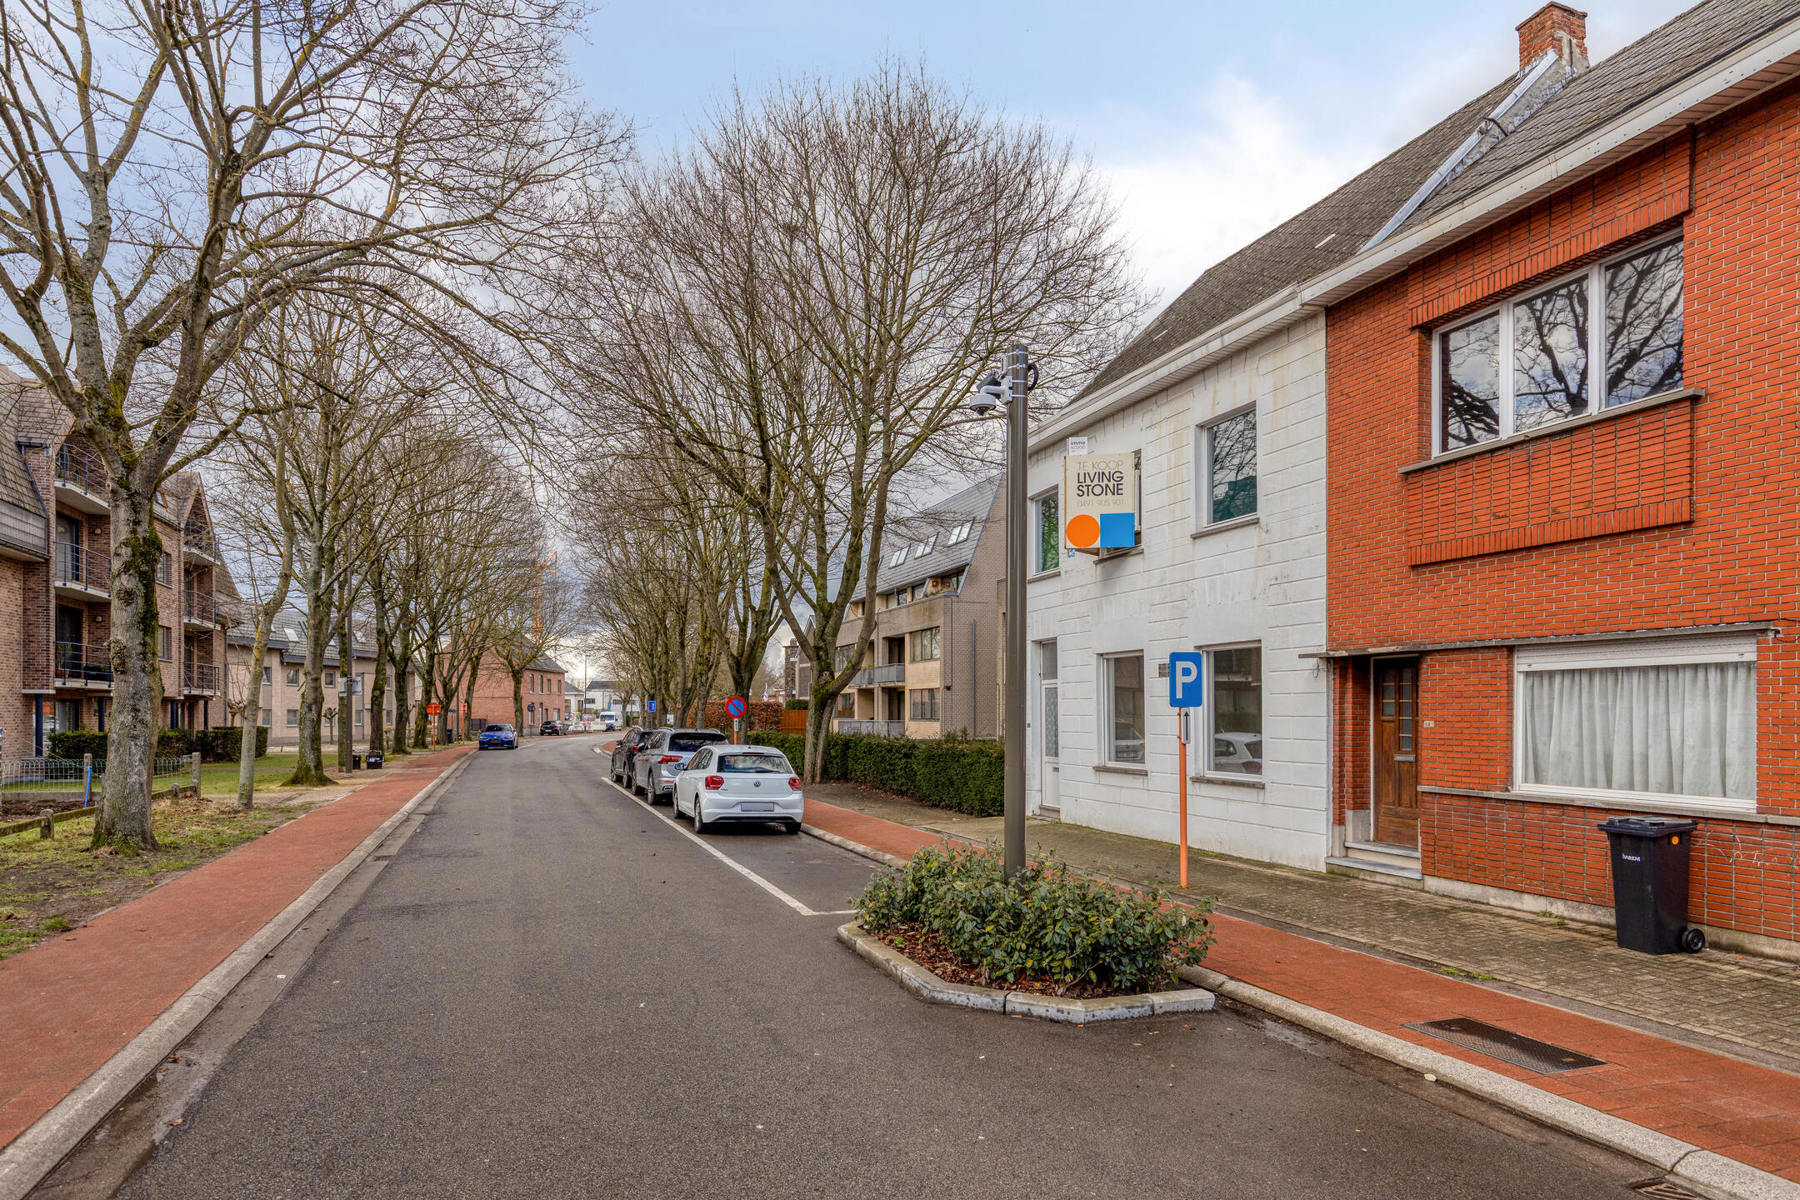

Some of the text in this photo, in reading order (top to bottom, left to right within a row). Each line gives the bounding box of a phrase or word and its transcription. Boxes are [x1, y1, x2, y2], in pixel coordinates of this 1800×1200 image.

[1078, 460, 1124, 471] TE KOOP
[1077, 470, 1124, 484] LIVING
[1077, 483, 1124, 497] STONE
[1175, 661, 1198, 699] P
